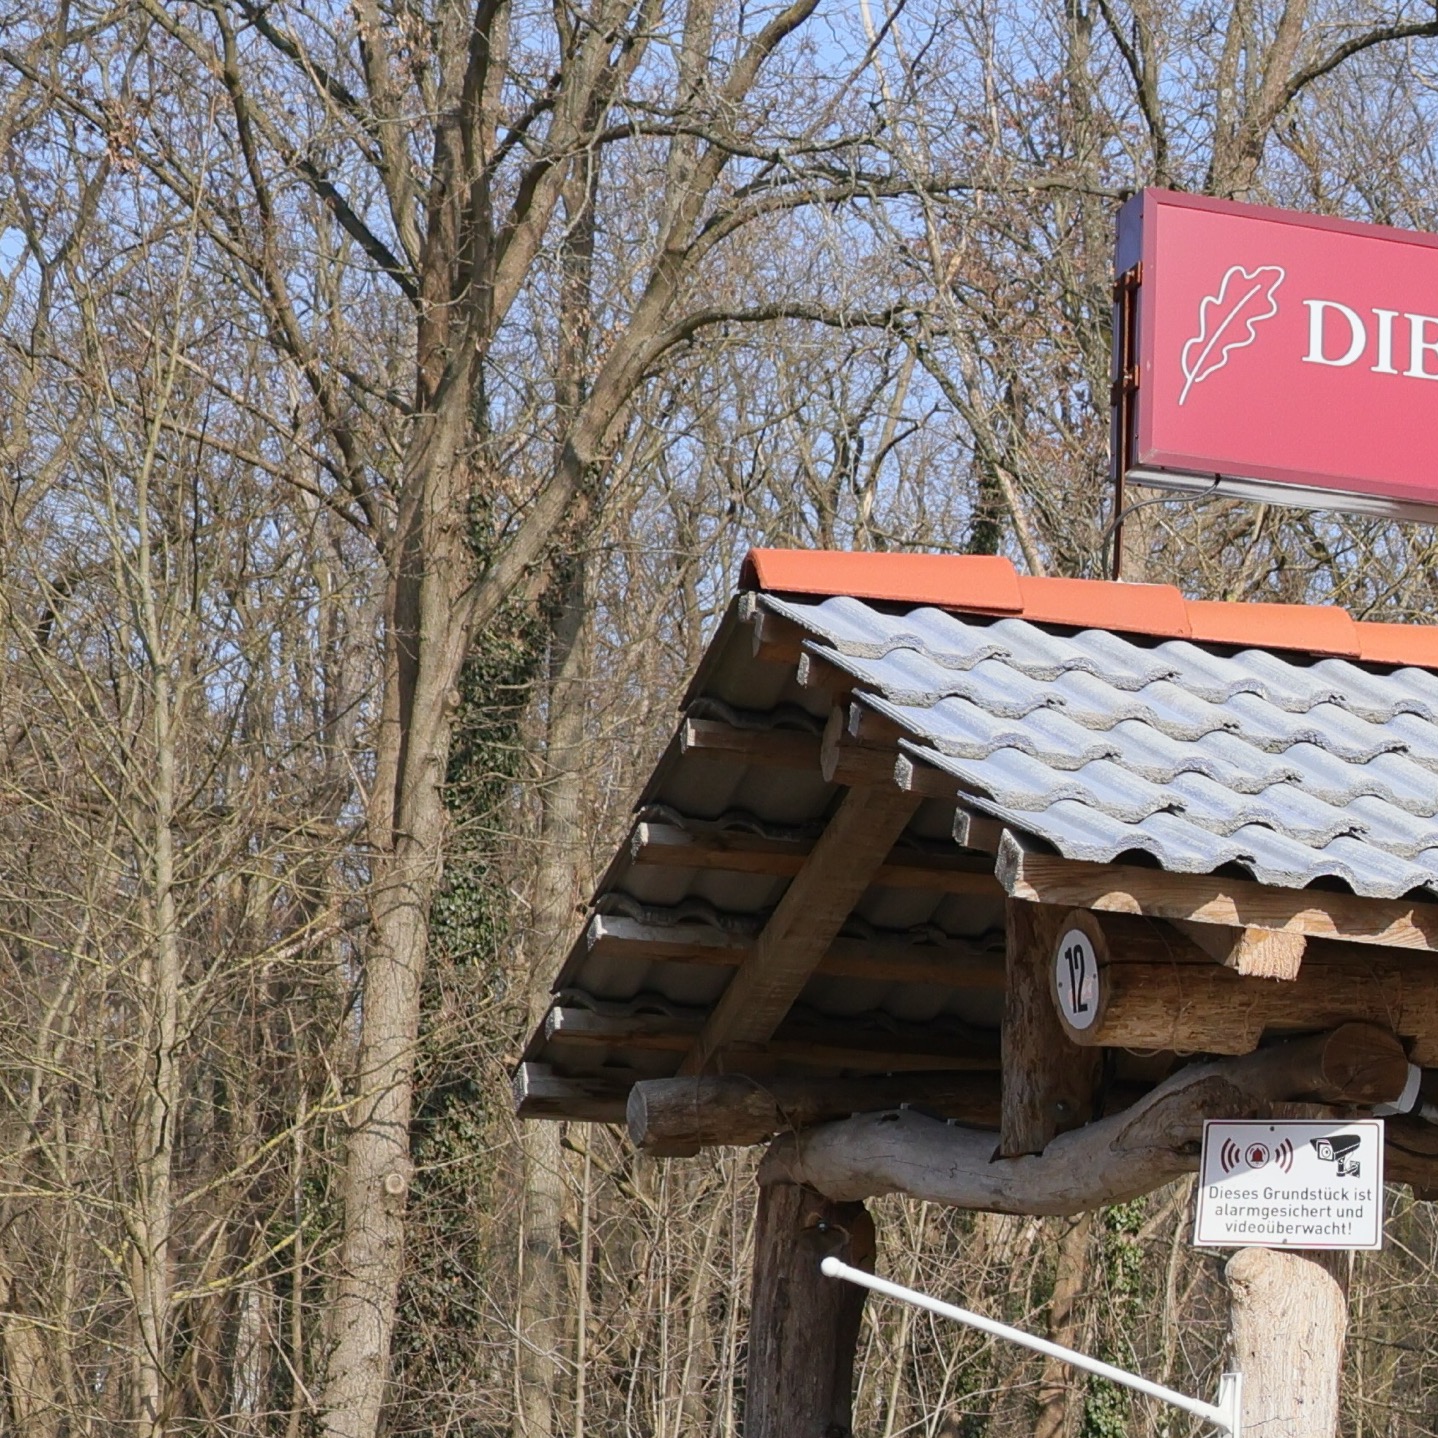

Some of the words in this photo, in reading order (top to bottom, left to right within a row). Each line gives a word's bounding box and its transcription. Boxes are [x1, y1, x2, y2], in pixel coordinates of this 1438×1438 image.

[1064, 944, 1088, 1014] 12
[1208, 1186, 1259, 1200] Dieses
[1263, 1186, 1349, 1201] Grundstück
[1354, 1188, 1372, 1201] ist
[1215, 1204, 1332, 1220] alarmgesichert
[1336, 1205, 1363, 1218] und
[1225, 1221, 1352, 1236] videoüberwacht!
